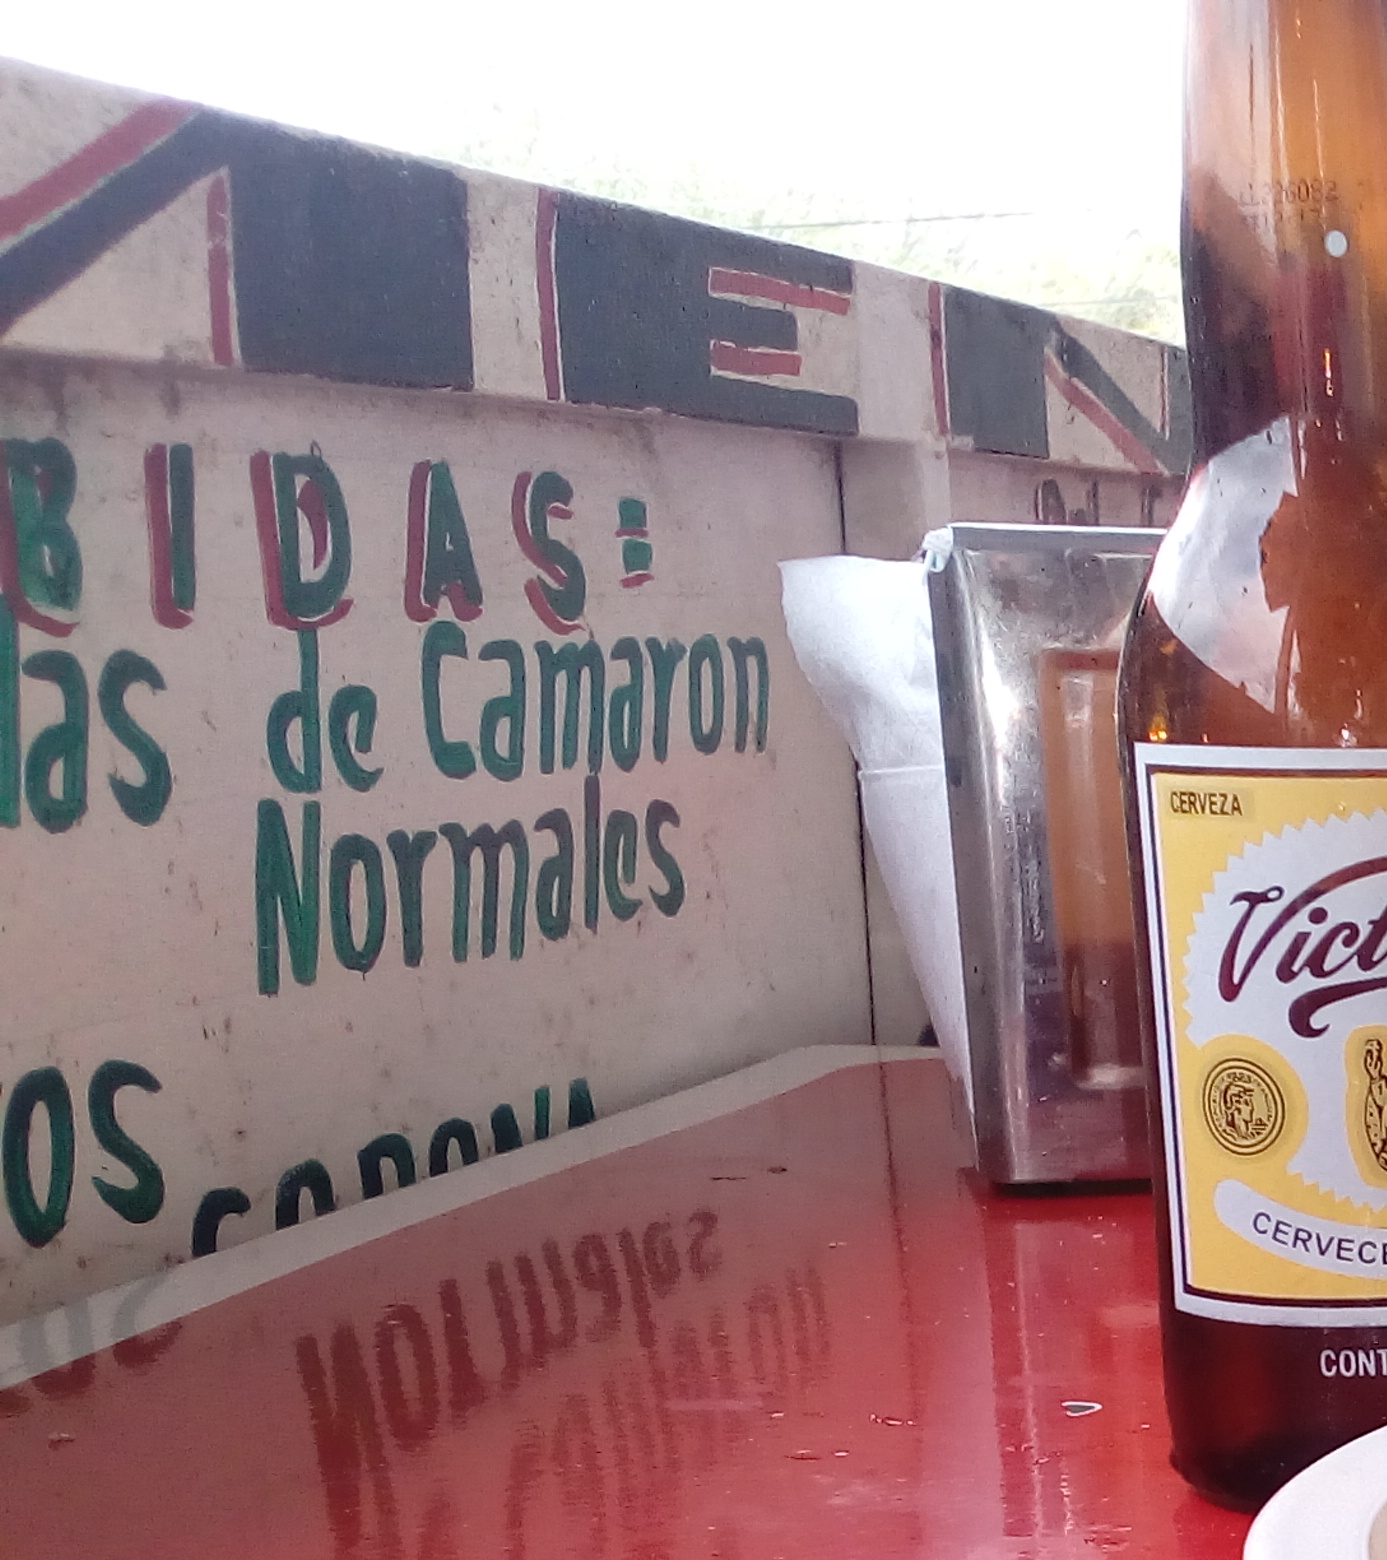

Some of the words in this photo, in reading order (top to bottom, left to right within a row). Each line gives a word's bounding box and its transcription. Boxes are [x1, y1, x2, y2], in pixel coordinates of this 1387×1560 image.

[266, 625, 384, 794] de
[421, 621, 771, 781] Camaron
[257, 773, 687, 996] Normales
[1169, 790, 1243, 818] CERVEZA
